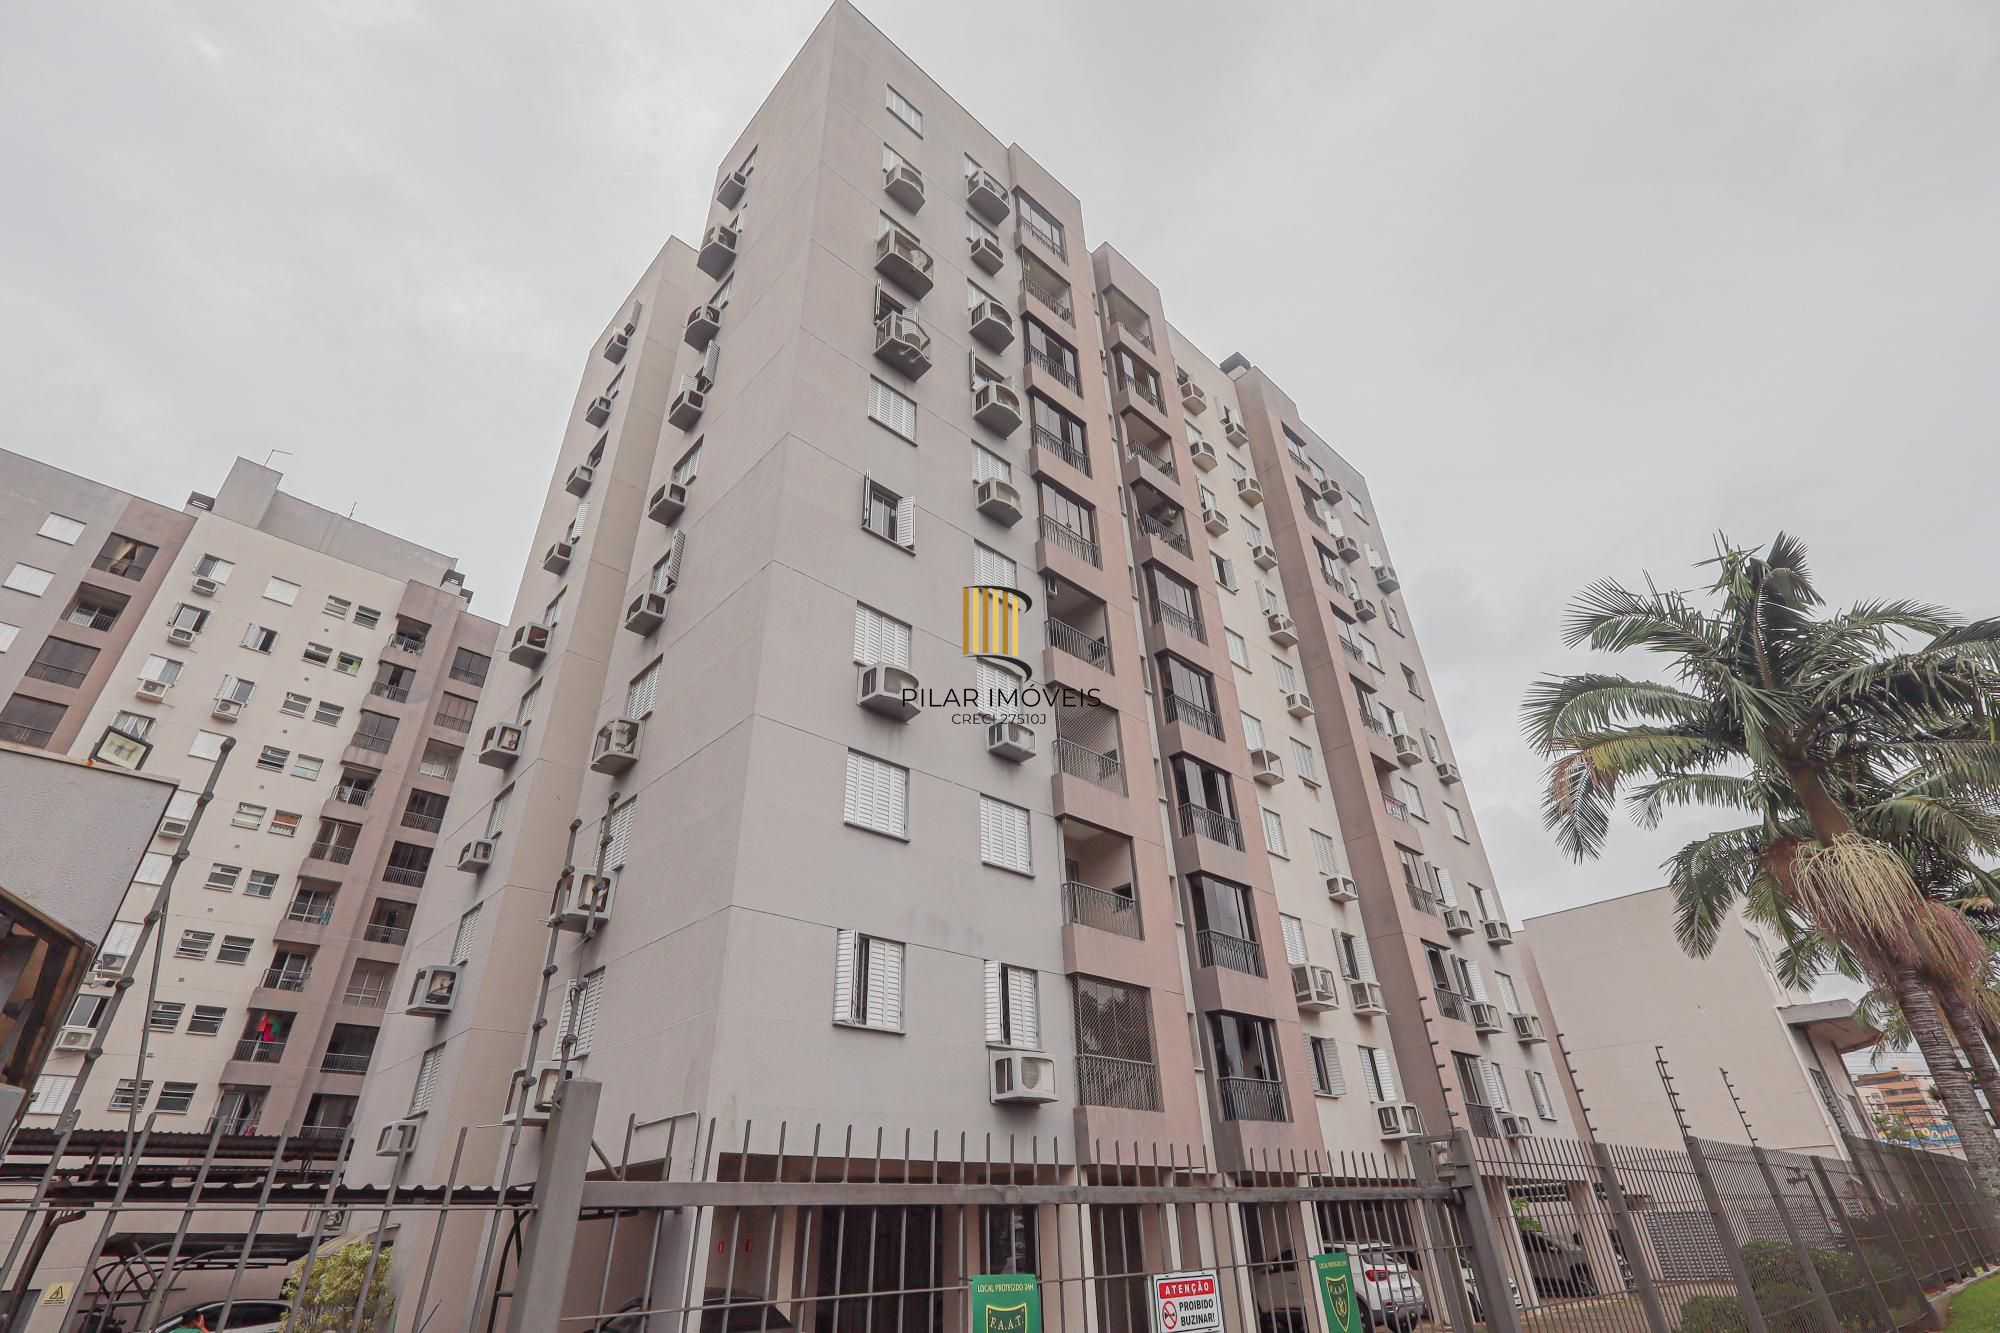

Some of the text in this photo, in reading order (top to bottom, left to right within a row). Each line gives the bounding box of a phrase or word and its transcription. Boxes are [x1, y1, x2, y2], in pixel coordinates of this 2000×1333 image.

[977, 1284, 994, 1293] LOCAL
[1165, 1281, 1209, 1296] ATENÇÃO
[1179, 1298, 1214, 1312] PROIBIDO
[1180, 1312, 1216, 1326] BUZINAR!
